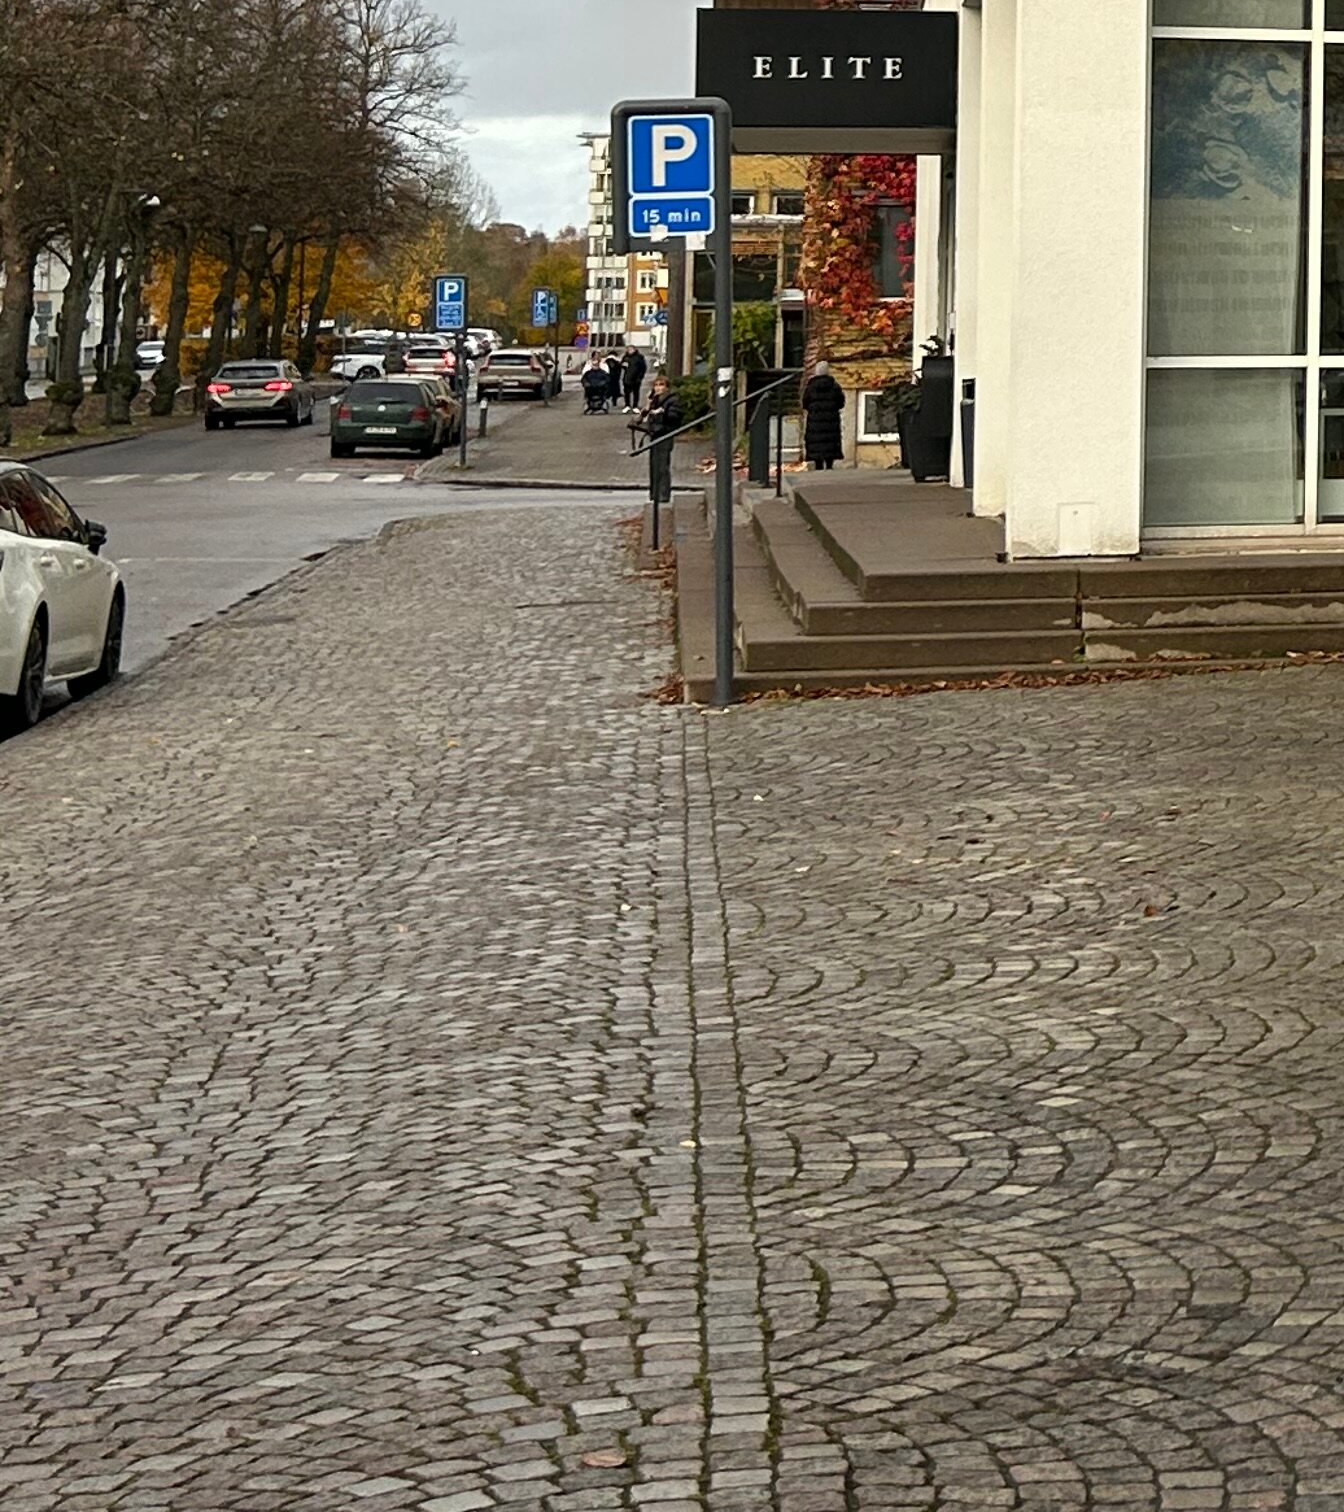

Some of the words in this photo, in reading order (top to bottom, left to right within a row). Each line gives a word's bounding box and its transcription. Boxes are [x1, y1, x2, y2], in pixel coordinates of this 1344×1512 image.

[752, 55, 904, 80] ELITE
[650, 123, 698, 187] P
[642, 208, 661, 224] 15
[667, 207, 702, 223] min
[444, 281, 459, 301] P
